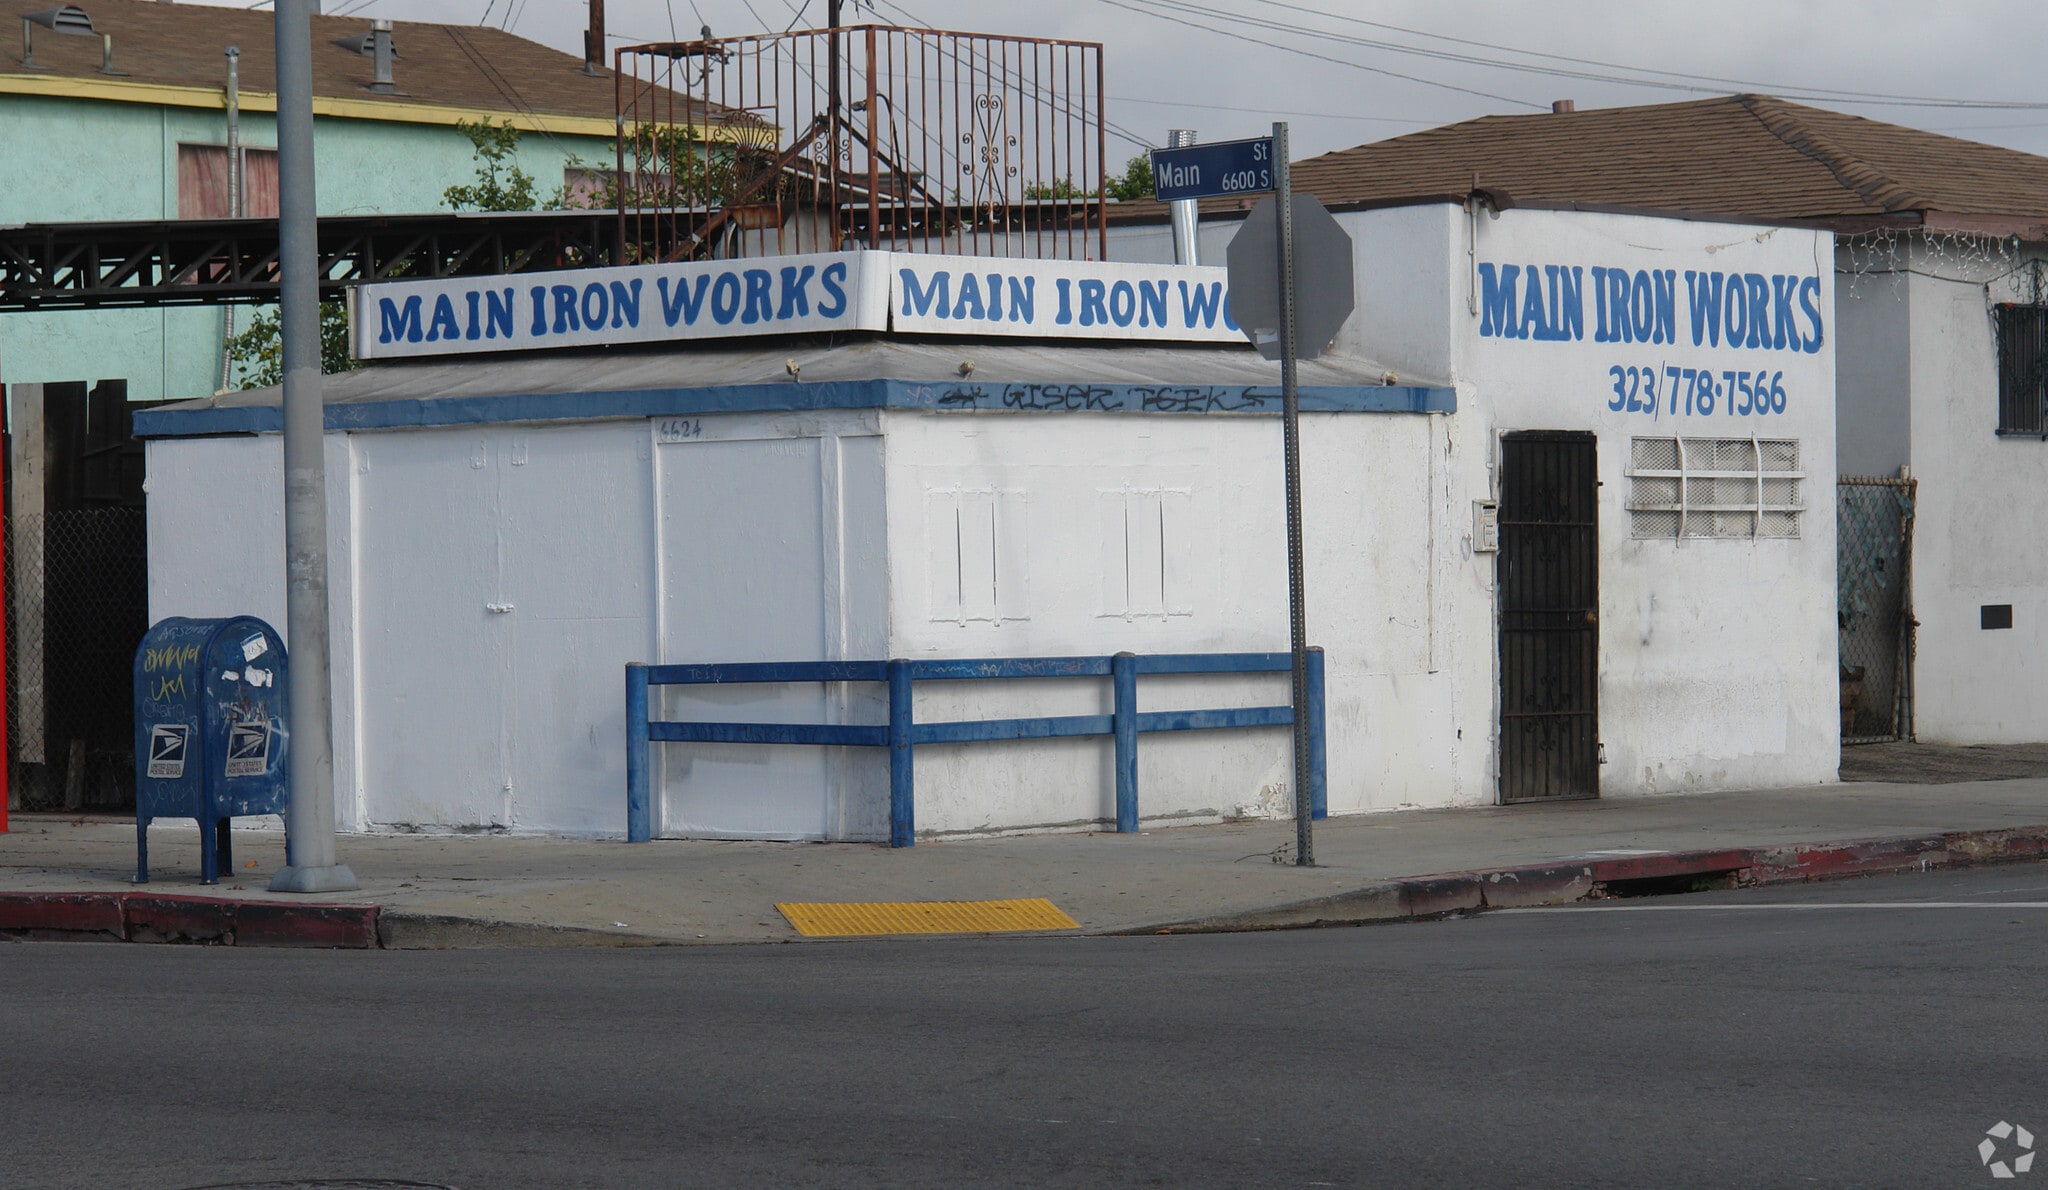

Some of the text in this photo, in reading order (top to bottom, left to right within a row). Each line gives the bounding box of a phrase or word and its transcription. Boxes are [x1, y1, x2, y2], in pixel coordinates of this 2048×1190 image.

[1158, 142, 1268, 189] Main St
[1221, 169, 1269, 191] 6600 S
[378, 262, 847, 344] MAIN IRON WORKS
[898, 268, 1035, 325] MAIN
[1055, 278, 1169, 329] IRON
[1477, 262, 1823, 355] MAIN IRON WORKS
